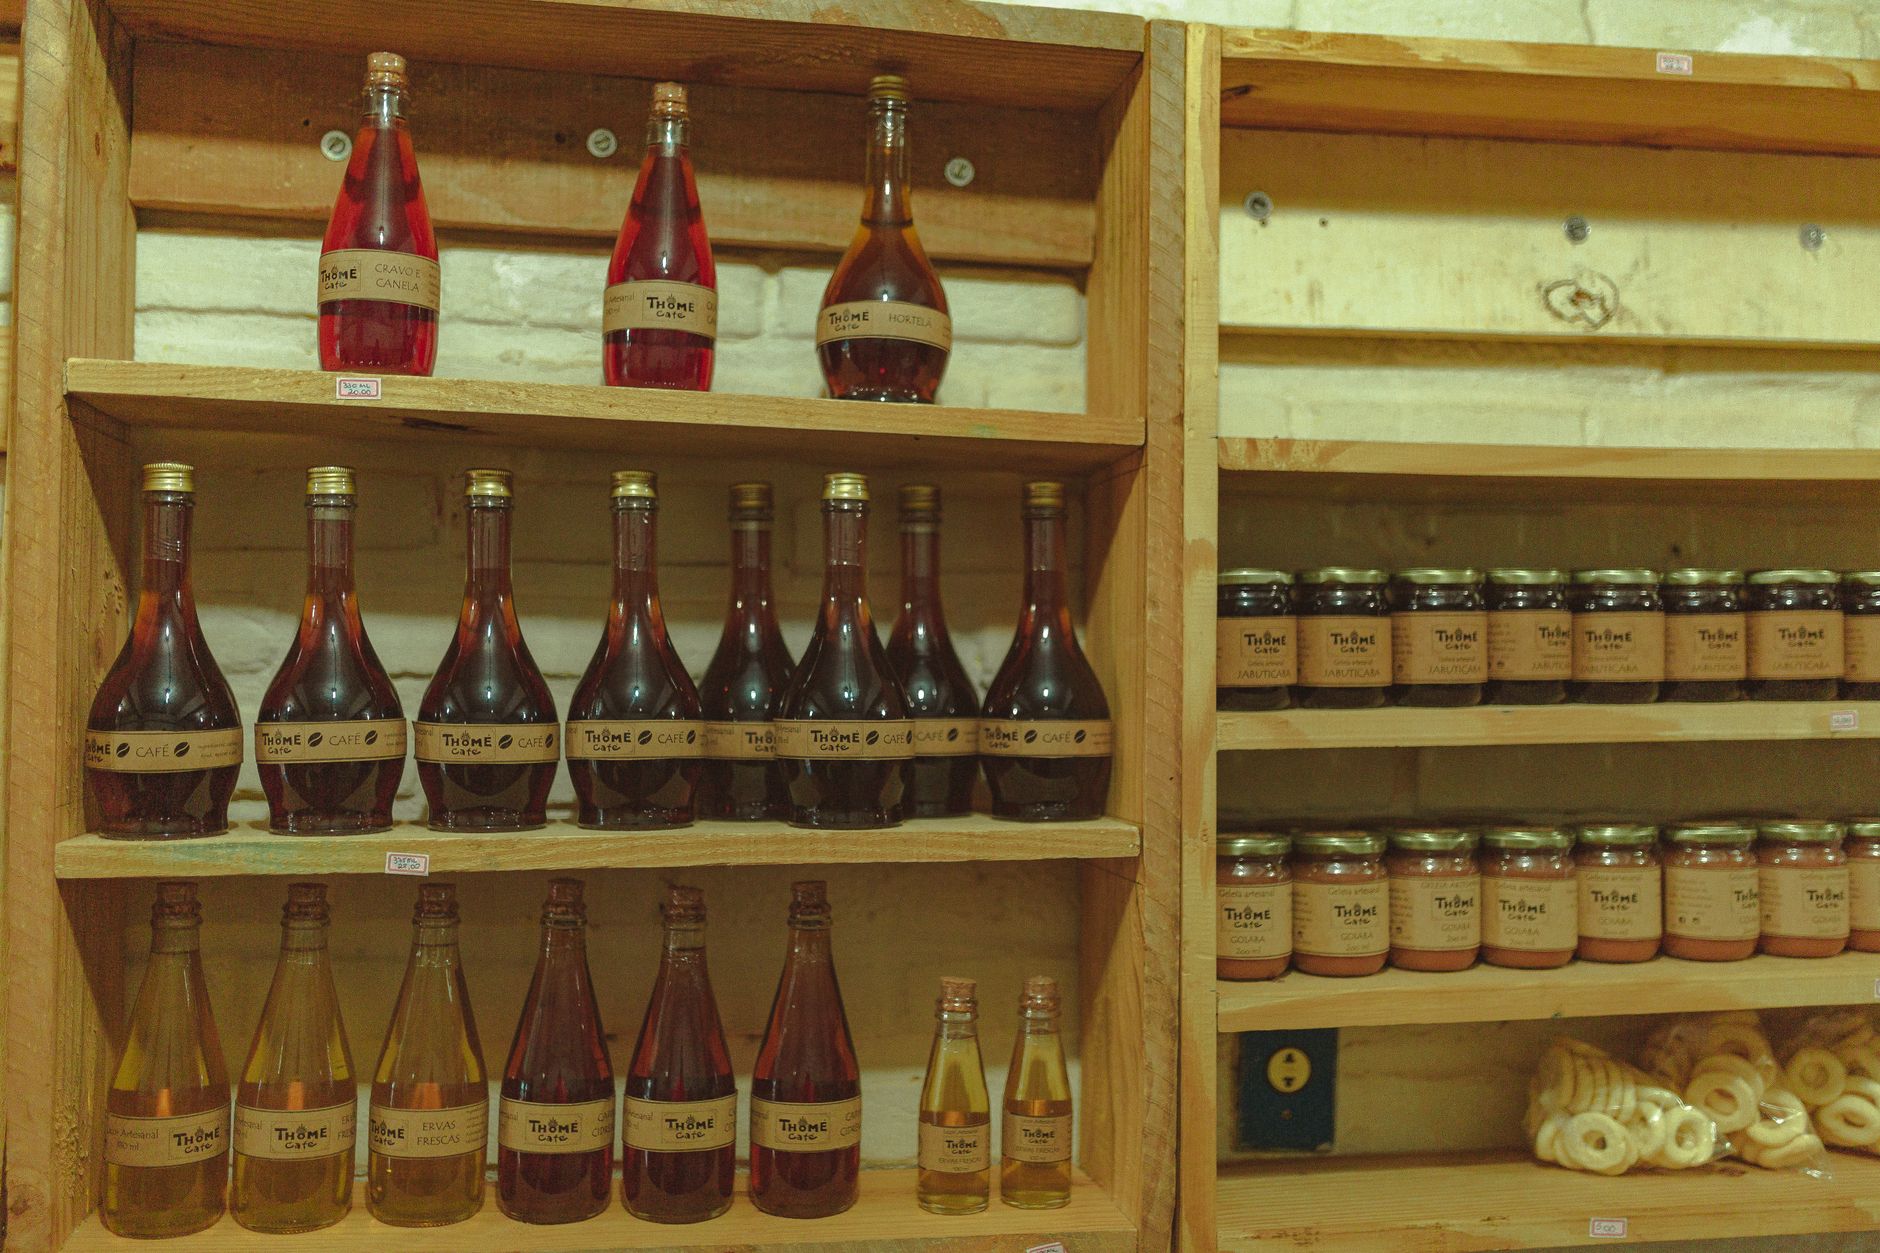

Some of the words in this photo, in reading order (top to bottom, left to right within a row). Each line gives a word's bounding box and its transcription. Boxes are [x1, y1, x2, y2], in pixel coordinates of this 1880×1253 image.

[375, 263, 413, 277] CRAVO
[415, 269, 421, 278] E
[376, 278, 419, 293] CANELA
[329, 733, 361, 746] CAFÉ
[518, 735, 543, 749] CAFÉ
[657, 731, 684, 744] CAFÉ
[1043, 731, 1071, 743] CAFÉ
[135, 744, 170, 758] CAFÉ
[422, 1120, 456, 1131] ERVAS
[417, 1135, 461, 1146] FRESCAS
